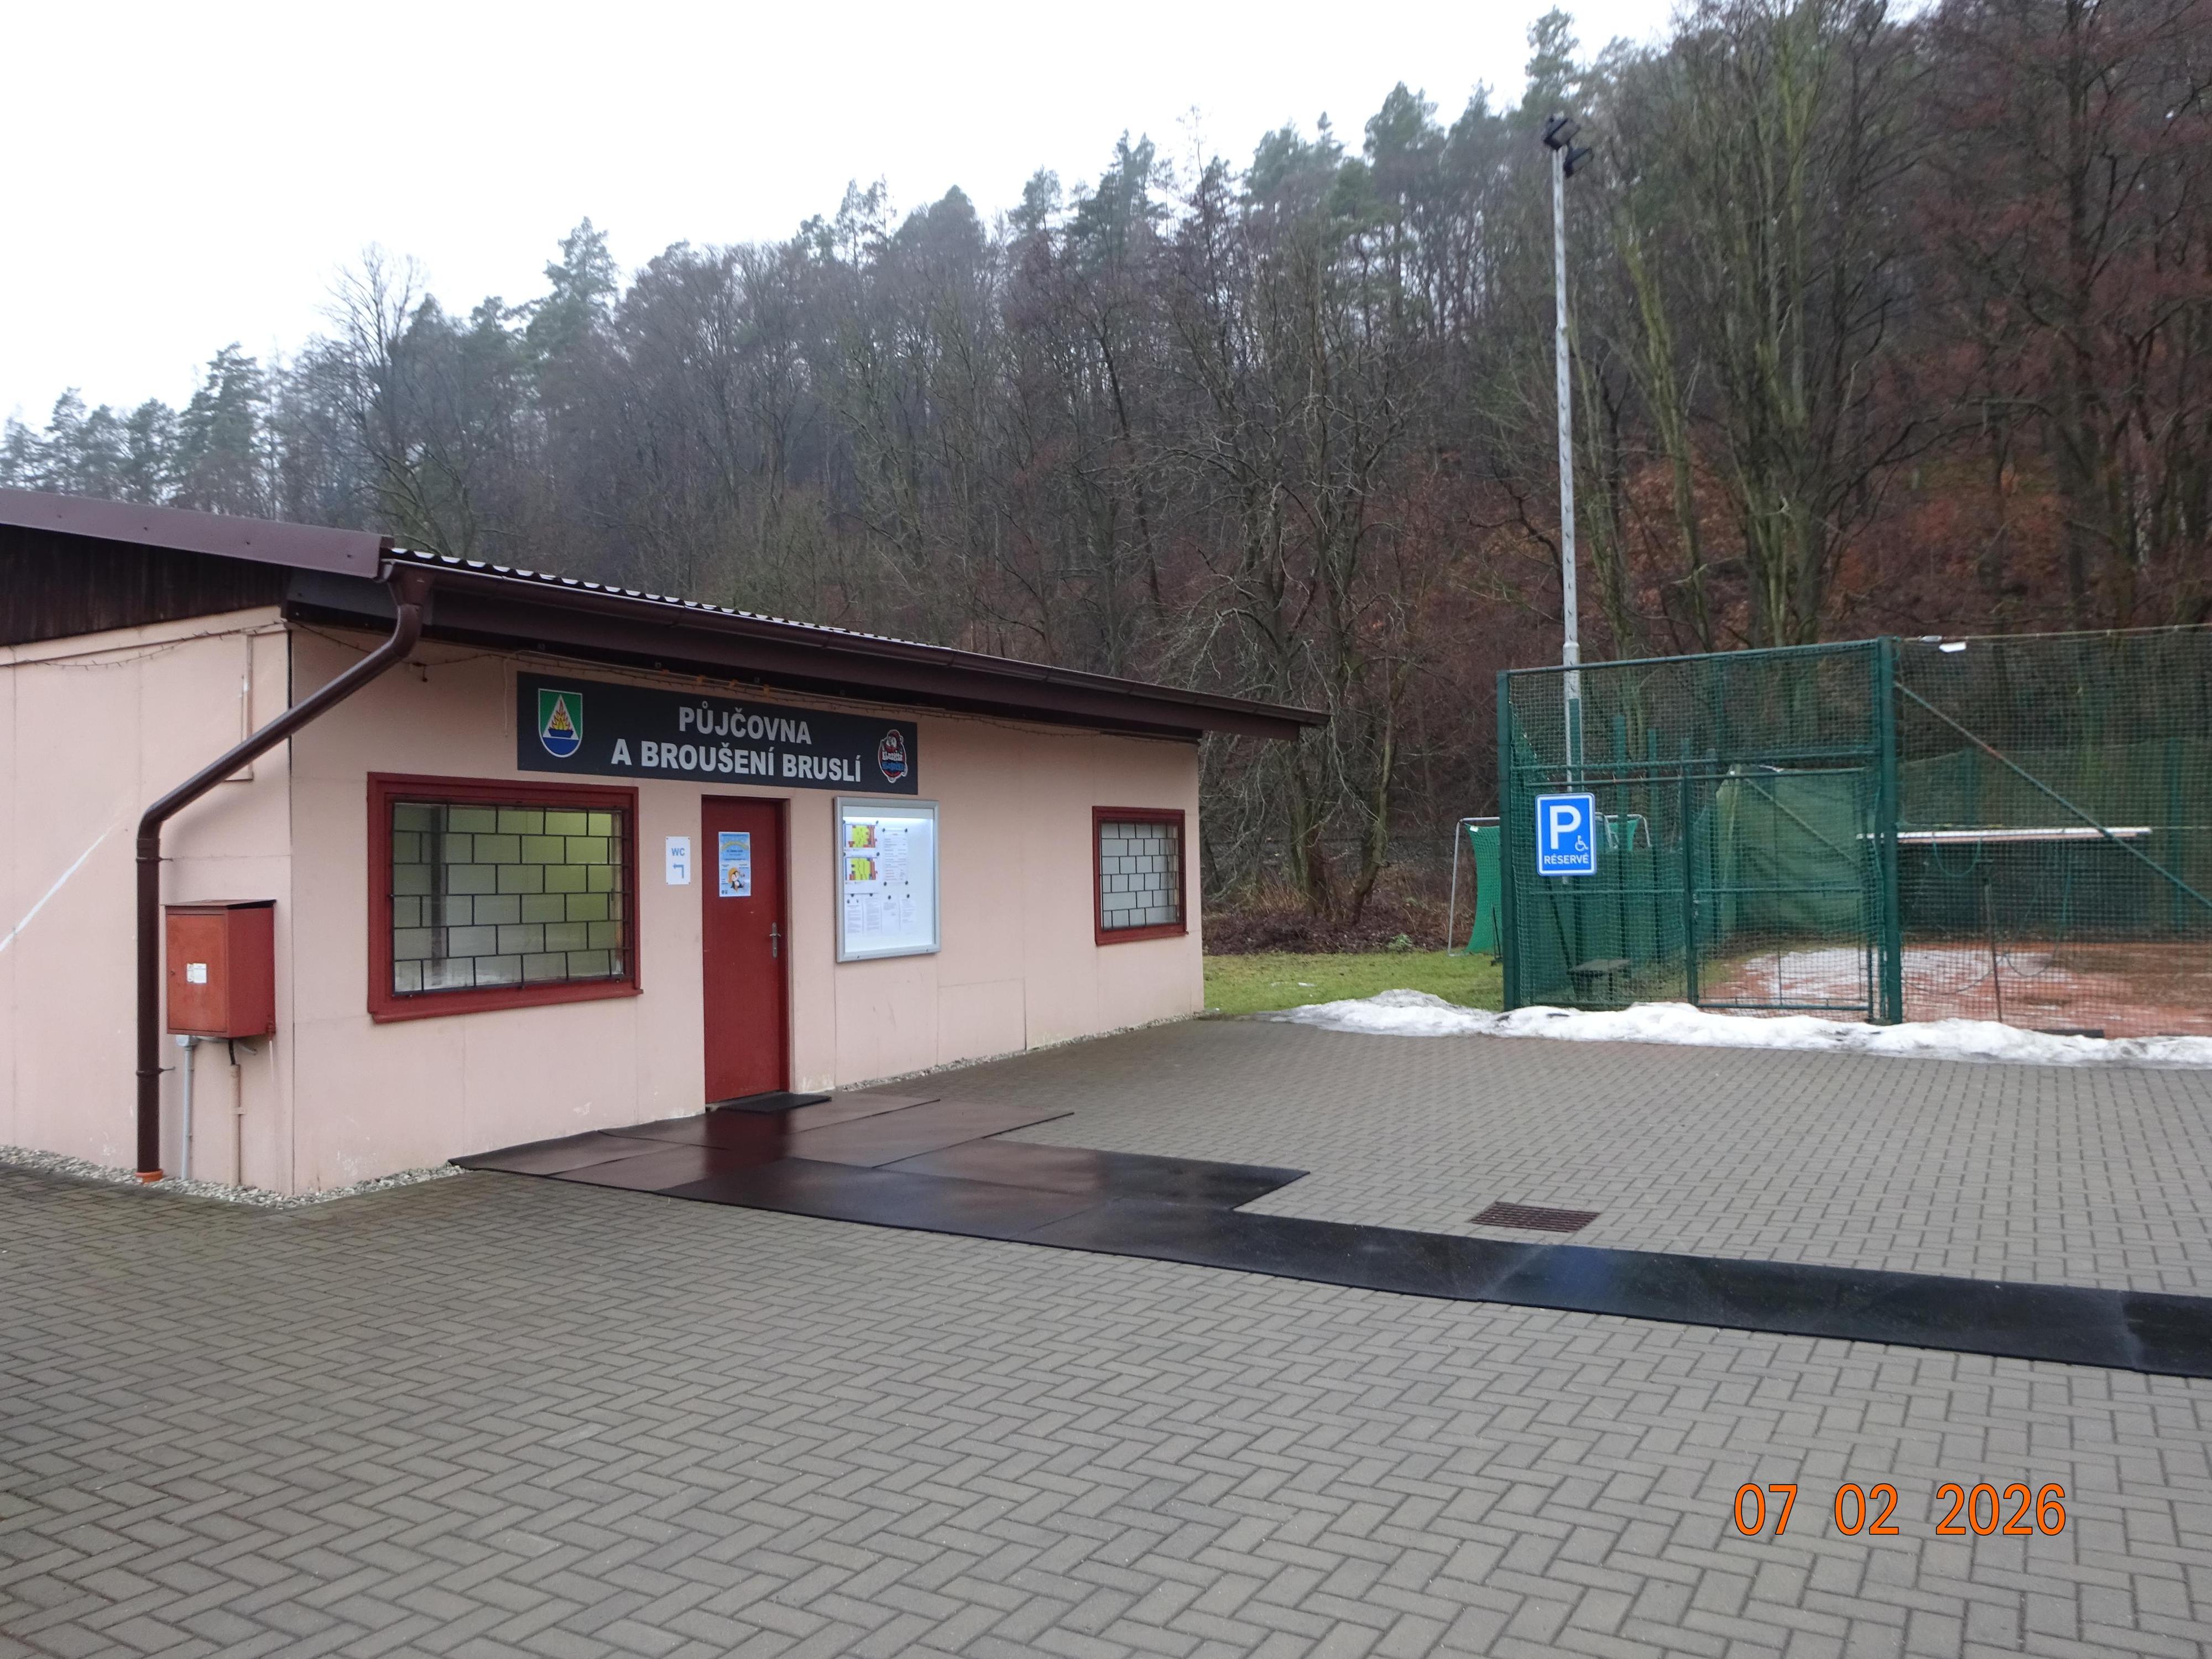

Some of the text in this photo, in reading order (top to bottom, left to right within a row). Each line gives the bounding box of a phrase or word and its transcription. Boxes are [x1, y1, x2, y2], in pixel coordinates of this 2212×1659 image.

[680, 700, 812, 744] PŮJČOVNA
[611, 738, 861, 782] A BROUŠENÍ BRUSLÍ
[1550, 805, 1582, 850] P
[671, 847, 685, 857] WC
